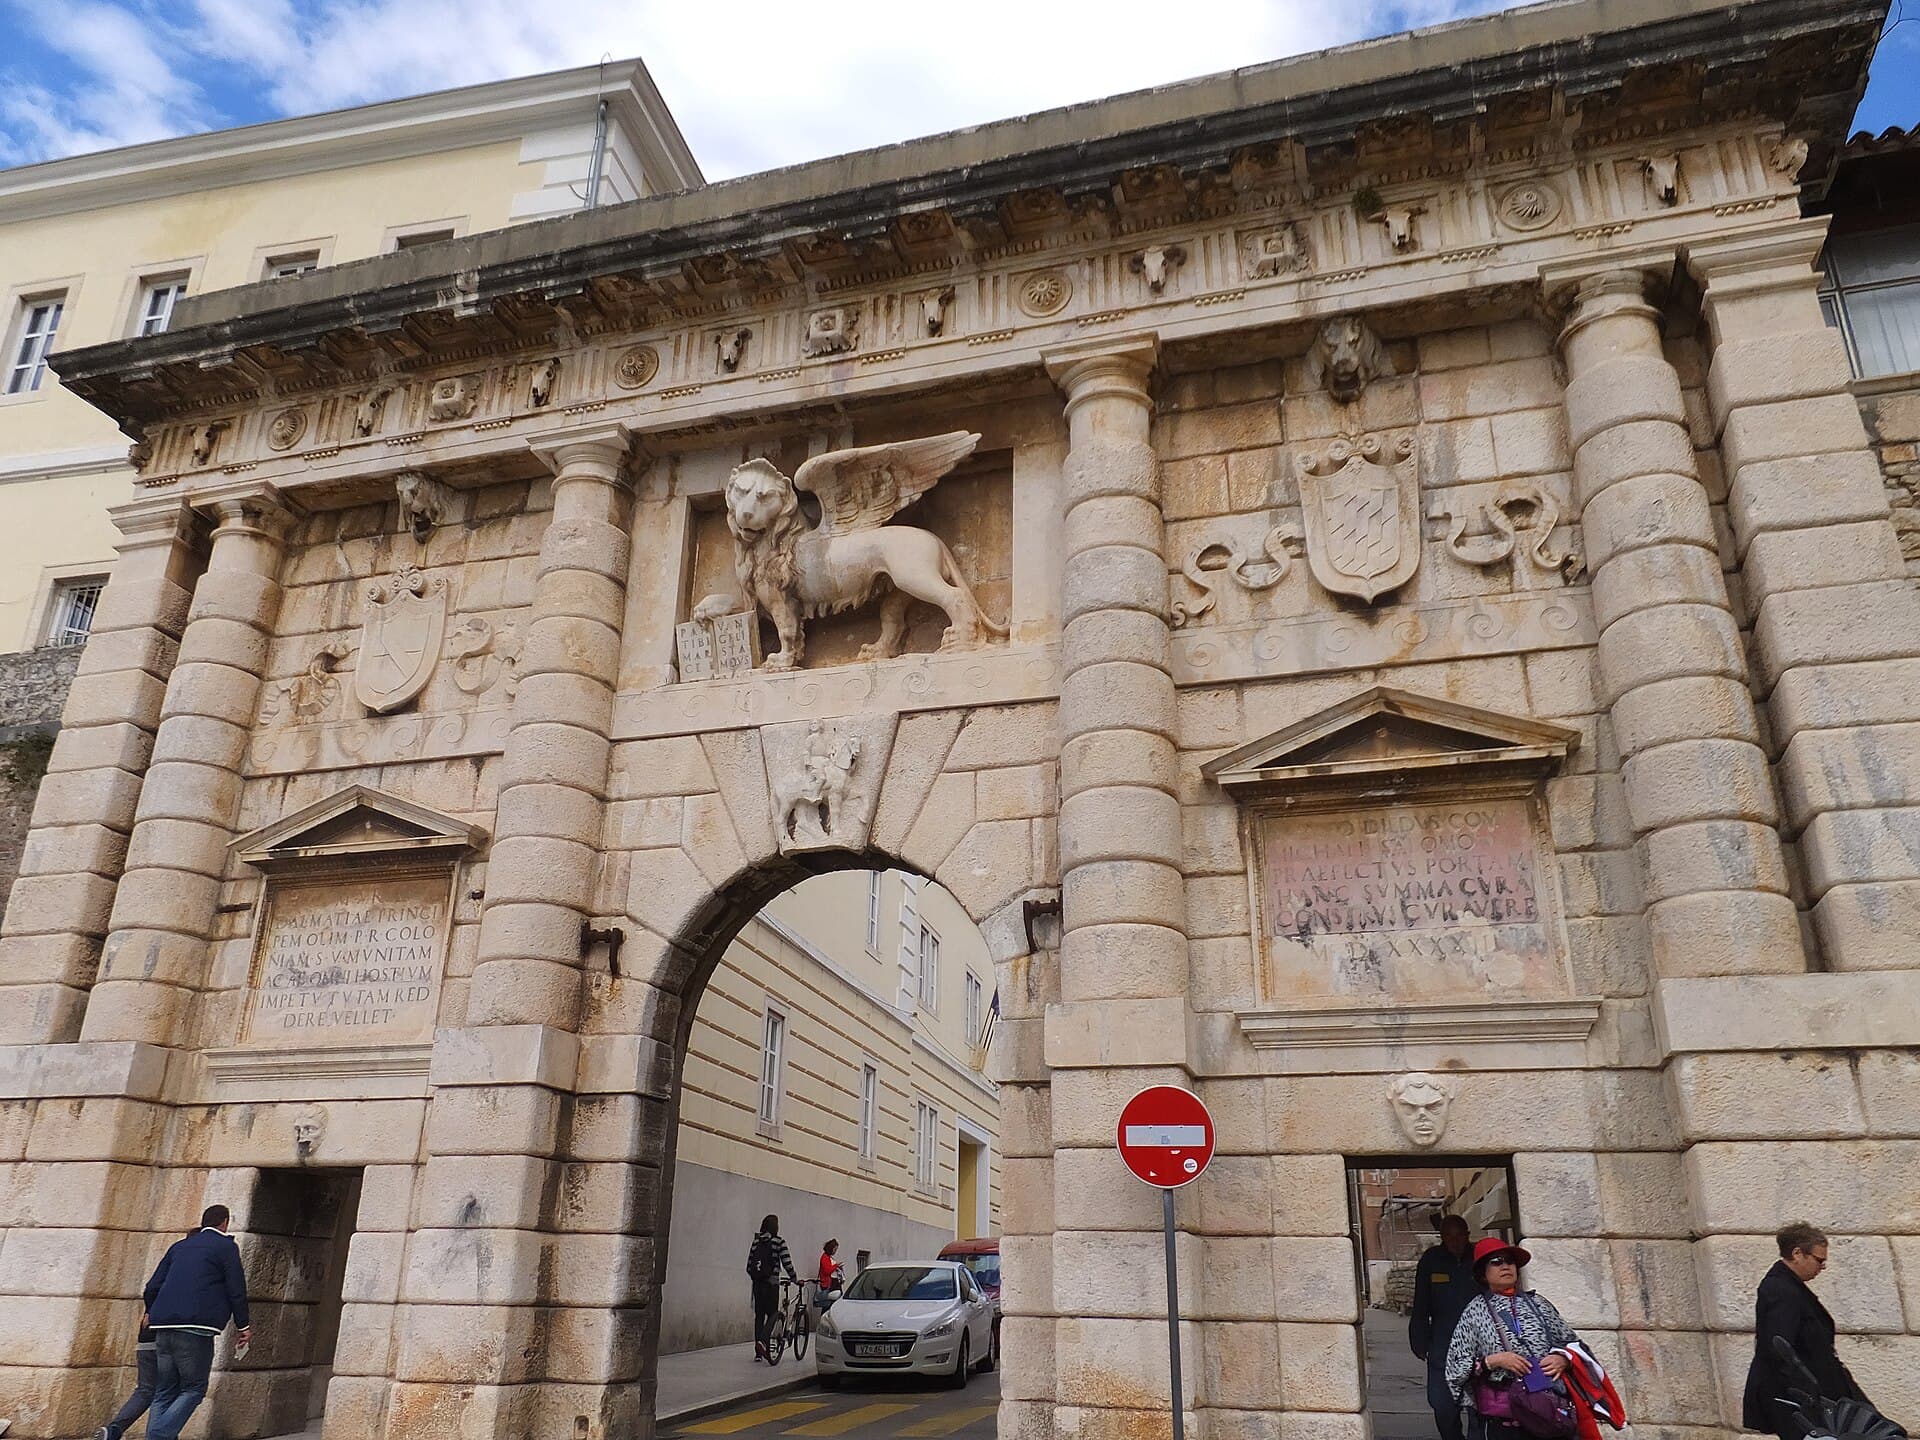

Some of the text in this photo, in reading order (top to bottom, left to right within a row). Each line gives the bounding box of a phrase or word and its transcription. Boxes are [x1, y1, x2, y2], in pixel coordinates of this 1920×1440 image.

[681, 637, 710, 649] TIBI
[1364, 880, 1453, 904] SVMMA
[272, 934, 302, 949] PEM
[385, 925, 435, 941] COLO
[355, 965, 433, 983] HOSTIVM
